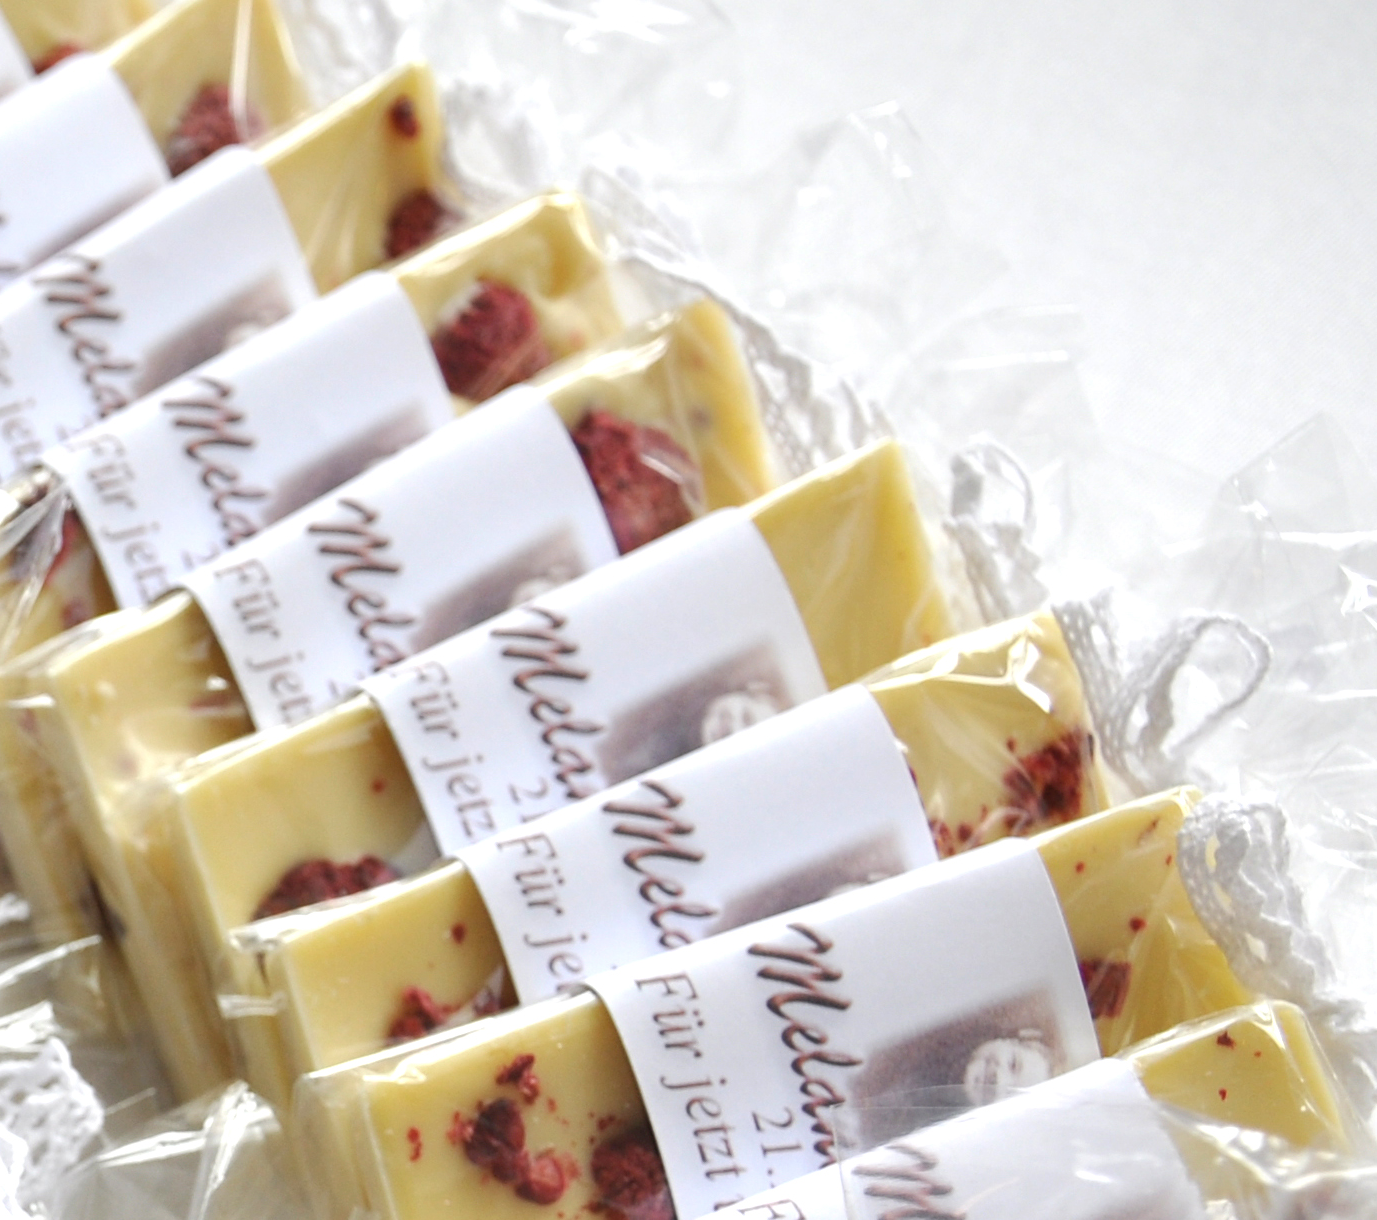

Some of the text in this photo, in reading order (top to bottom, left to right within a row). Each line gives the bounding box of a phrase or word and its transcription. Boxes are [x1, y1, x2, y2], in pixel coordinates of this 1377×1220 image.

[215, 558, 282, 640] Für
[496, 832, 567, 917] Für
[635, 971, 704, 1058] Für
[661, 1075, 747, 1182] jetzt
